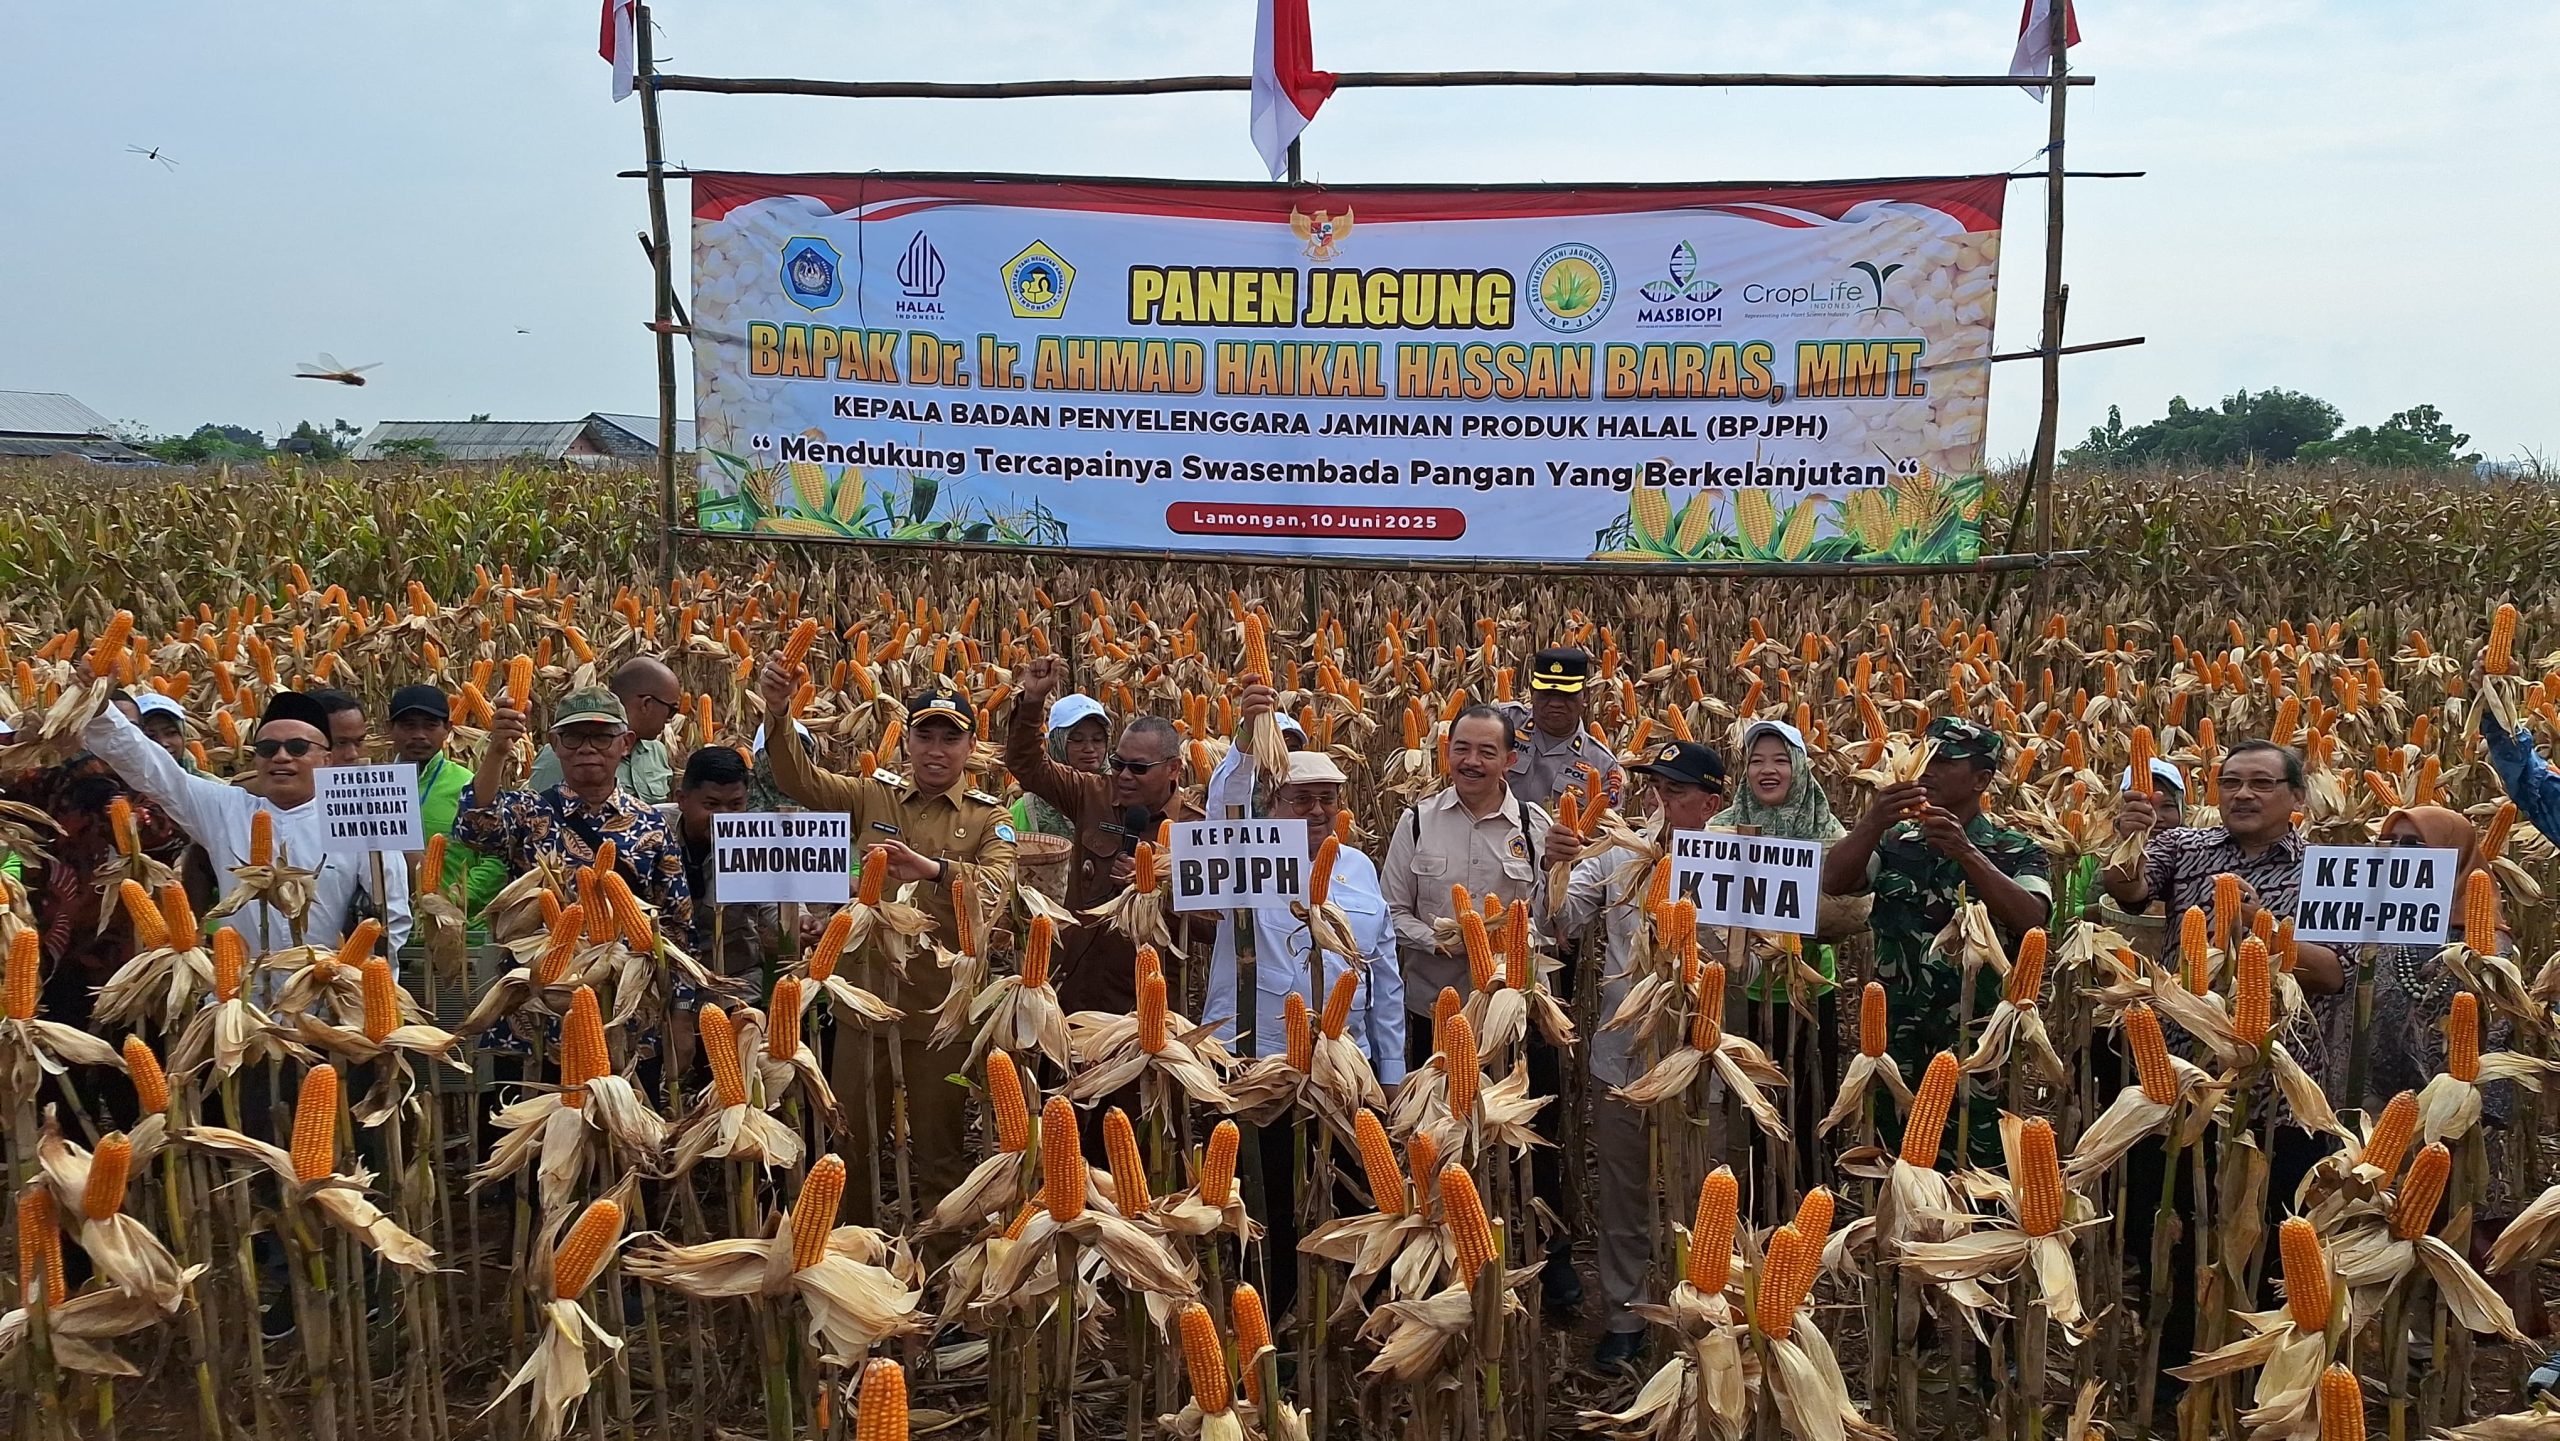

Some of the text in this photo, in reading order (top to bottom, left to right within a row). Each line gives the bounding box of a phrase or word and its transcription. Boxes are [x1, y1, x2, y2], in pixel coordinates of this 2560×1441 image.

[1018, 258, 1030, 269] TANI
[1532, 248, 1611, 302] ASOSIASI PETANI JAGUNG INDONESIA
[896, 301, 945, 313] HALAL
[1018, 296, 1058, 310] INDONESIA
[1129, 266, 1515, 330] PANEN JAGUNG
[1743, 281, 1864, 307] CropLife
[1637, 307, 1722, 322] MASBIOPI
[750, 323, 1926, 405] BAPAK Dr. Ir. AHMAD HAIKAL HASSAN BARAS, MMT.
[834, 396, 1829, 442] KEPALA BADAN PENYELENGGARA JAMINAN PRODUK HALAL (BPJPH)
[781, 437, 966, 473] Mendukung
[974, 448, 1172, 483] Tercapainya
[1182, 455, 1399, 484] Swasembada
[1411, 460, 1535, 491] Pangan
[1546, 461, 1633, 491] Yang
[1645, 459, 1886, 491] Berkelanjutan
[1193, 510, 1438, 529] Lamongan, 10 Juni 2025
[333, 771, 395, 785] PENGASUH
[325, 786, 407, 799] PONDOK PESANTREN
[326, 800, 408, 817] SUNAN DRAJAT
[330, 820, 408, 838] LAMONGAN
[716, 820, 846, 838] WAKIL BUPATI
[1192, 826, 1281, 846] KEPALA
[718, 846, 847, 873] LAMONGAN
[1677, 838, 1814, 868] KETUA UMUM
[1180, 857, 1299, 897] BPJPH
[2316, 857, 2434, 889] KETUA
[1678, 870, 1800, 919] KTNA
[2298, 901, 2441, 933] KKH-PRG
